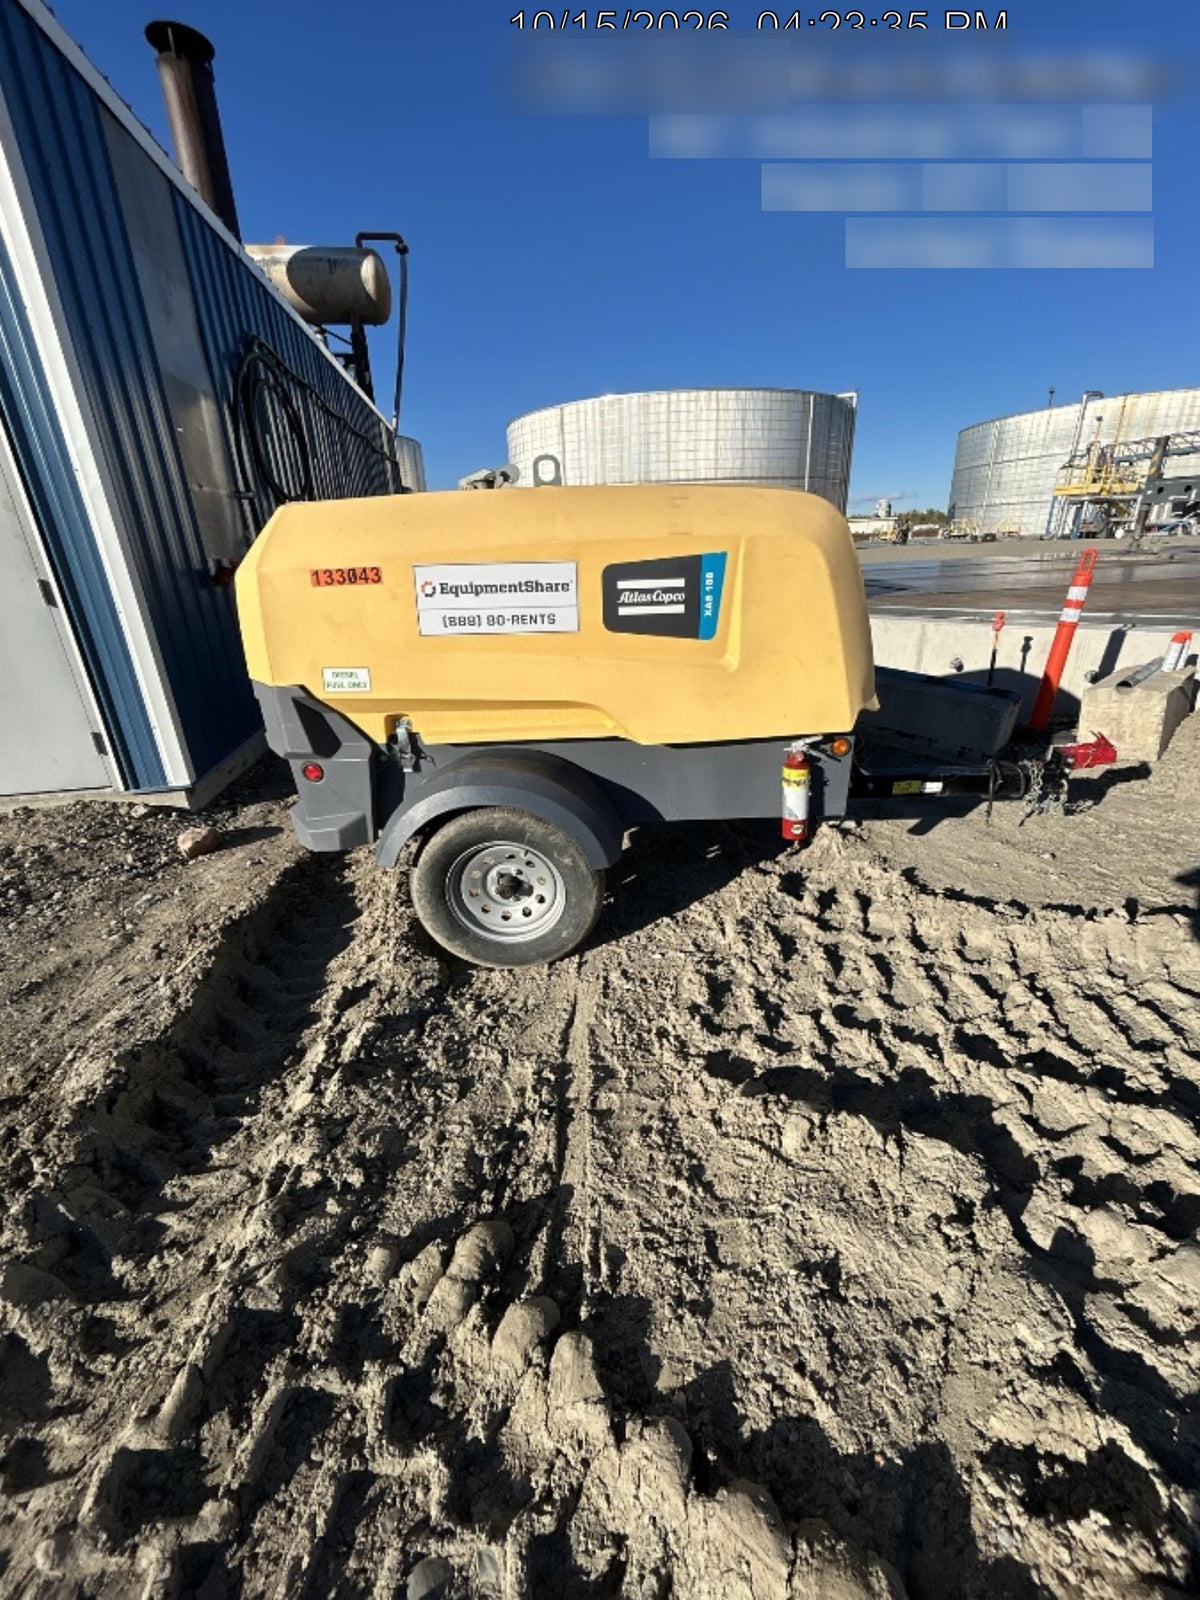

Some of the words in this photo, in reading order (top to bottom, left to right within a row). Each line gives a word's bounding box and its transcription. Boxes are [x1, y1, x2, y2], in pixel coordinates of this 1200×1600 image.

[311, 566, 381, 586] 133043
[438, 579, 570, 598] EquipmentShare
[442, 614, 482, 628] (888)
[486, 613, 556, 627] 80-RENTS
